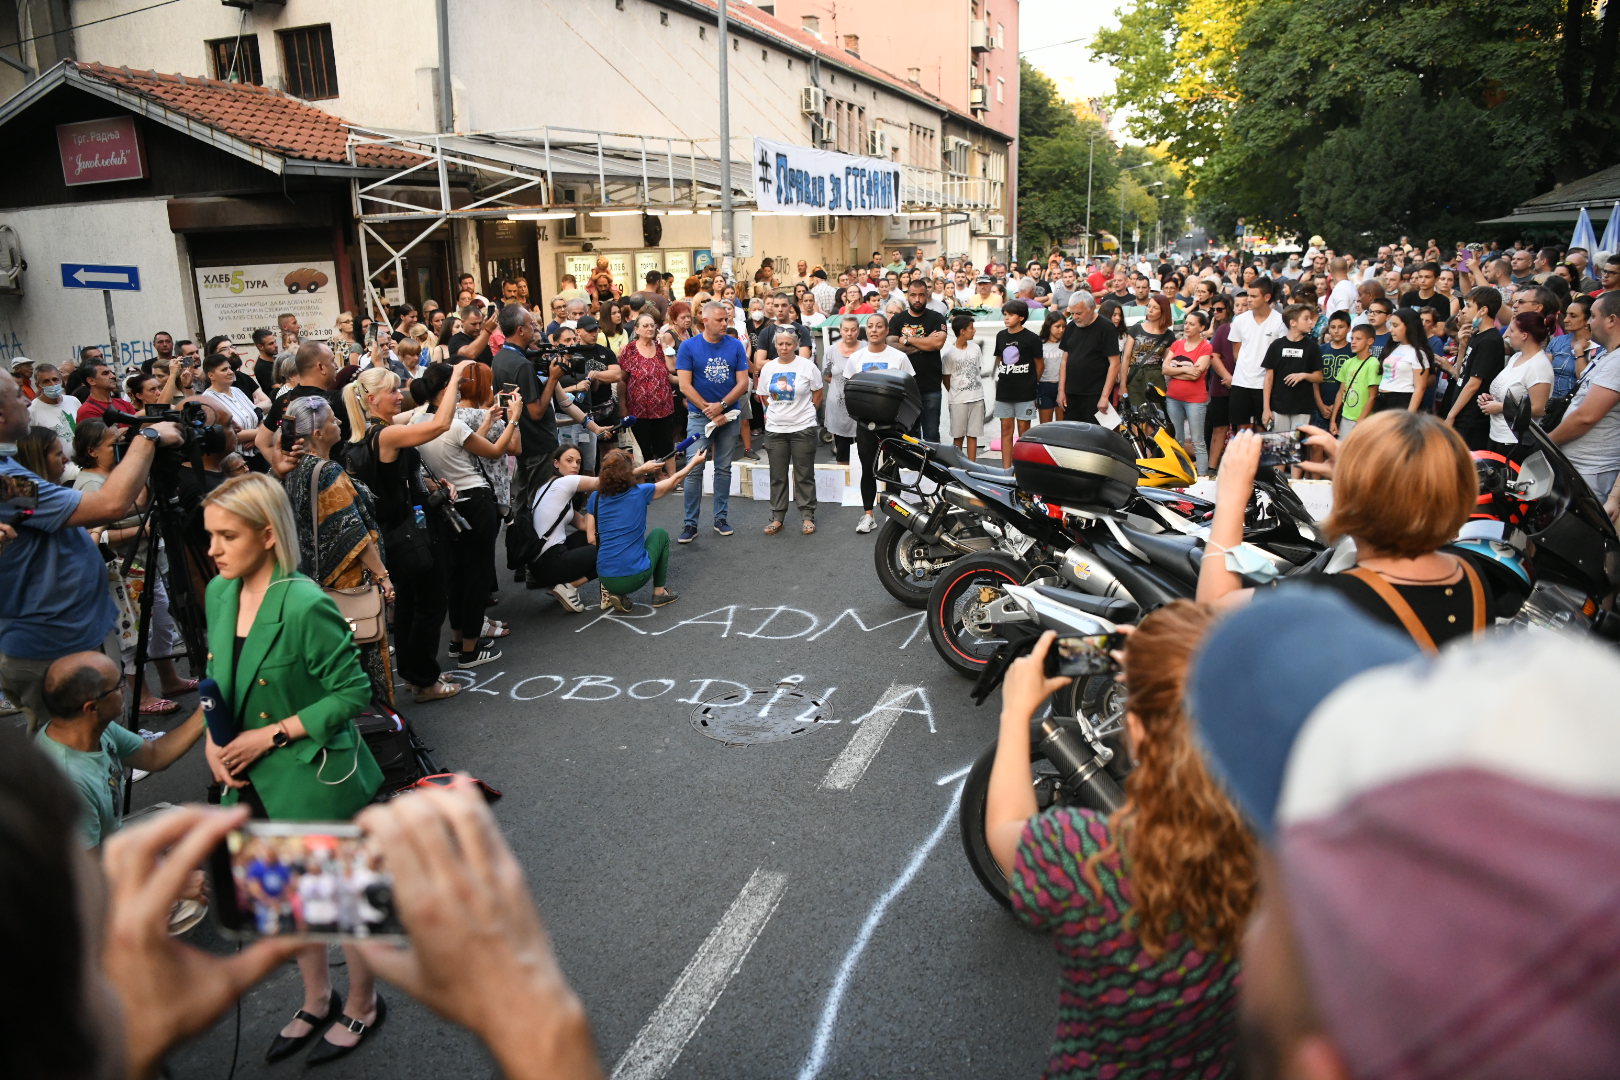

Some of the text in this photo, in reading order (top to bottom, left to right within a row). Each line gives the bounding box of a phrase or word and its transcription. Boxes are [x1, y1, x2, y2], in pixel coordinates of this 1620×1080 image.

[90, 130, 120, 143] Радња
[203, 273, 230, 284] ХЛЕБ
[229, 270, 245, 294] 5
[245, 279, 269, 289] ТУРА
